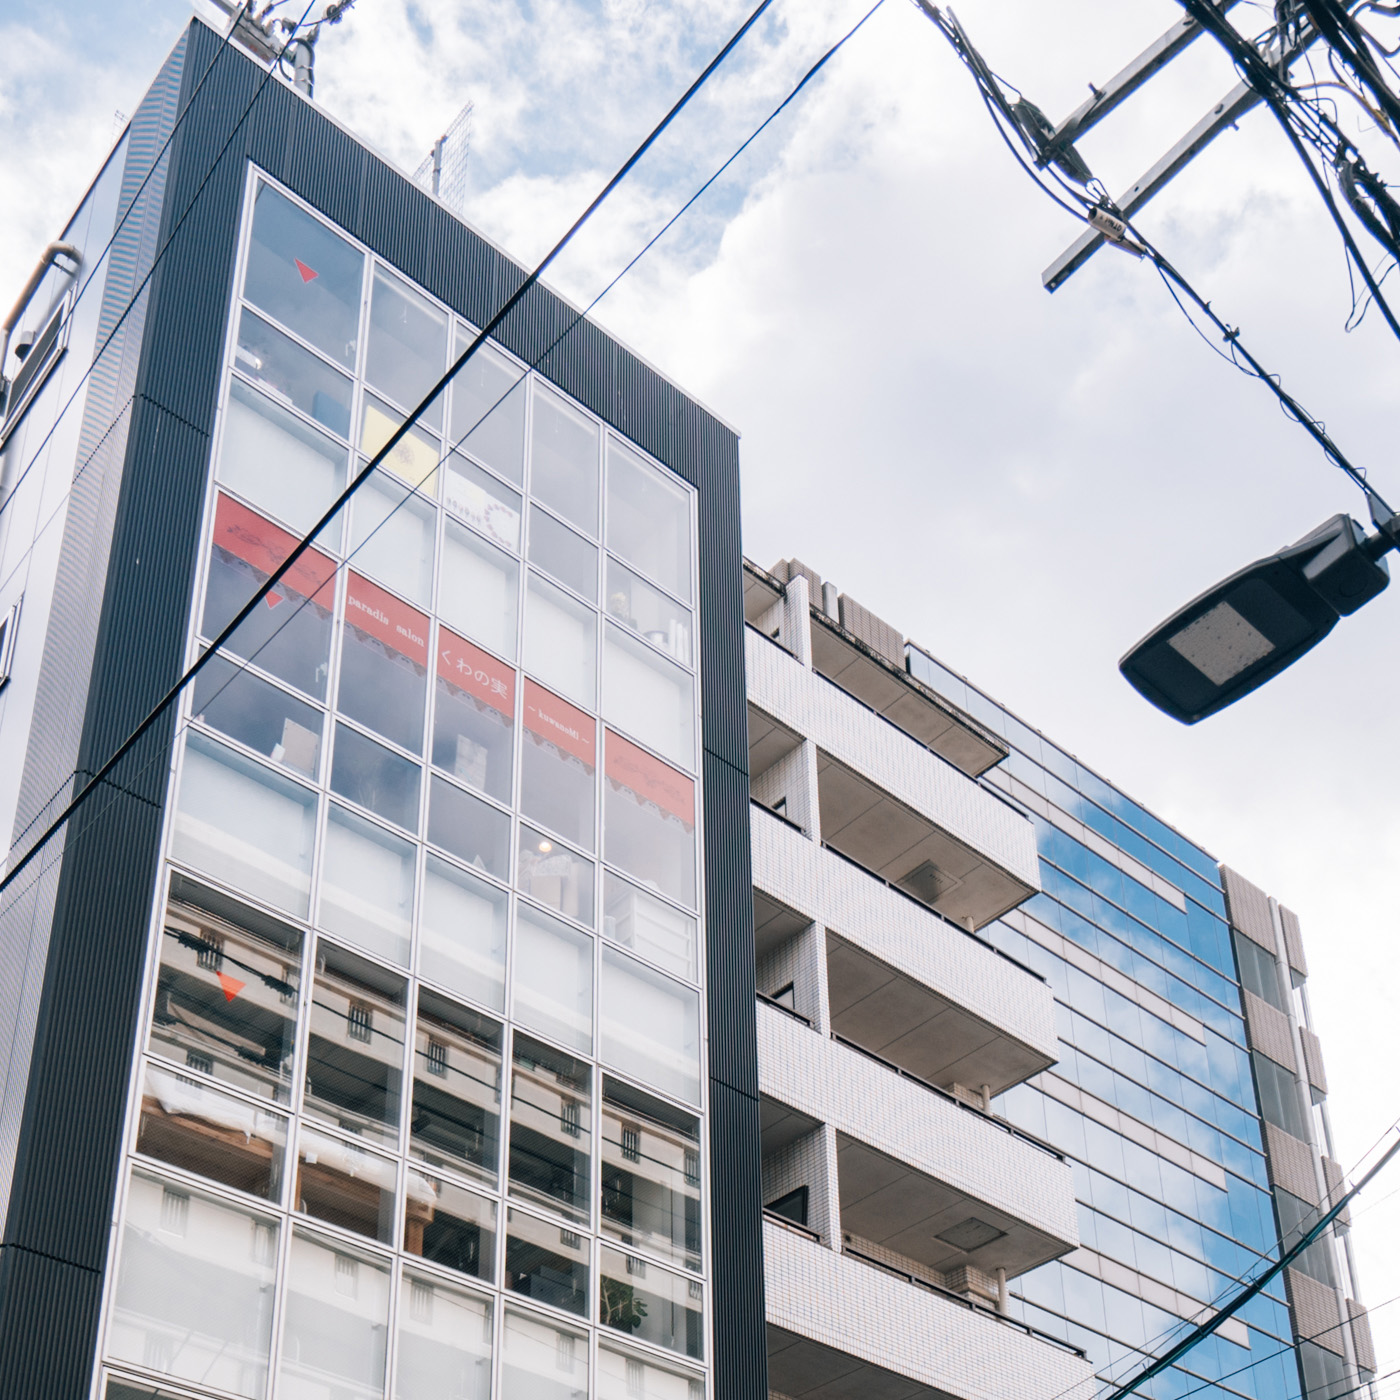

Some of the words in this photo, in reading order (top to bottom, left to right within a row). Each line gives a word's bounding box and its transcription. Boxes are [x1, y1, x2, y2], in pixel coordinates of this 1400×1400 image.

[347, 595, 389, 626] paradis
[396, 623, 425, 647] salon
[441, 650, 508, 699] くわの実
